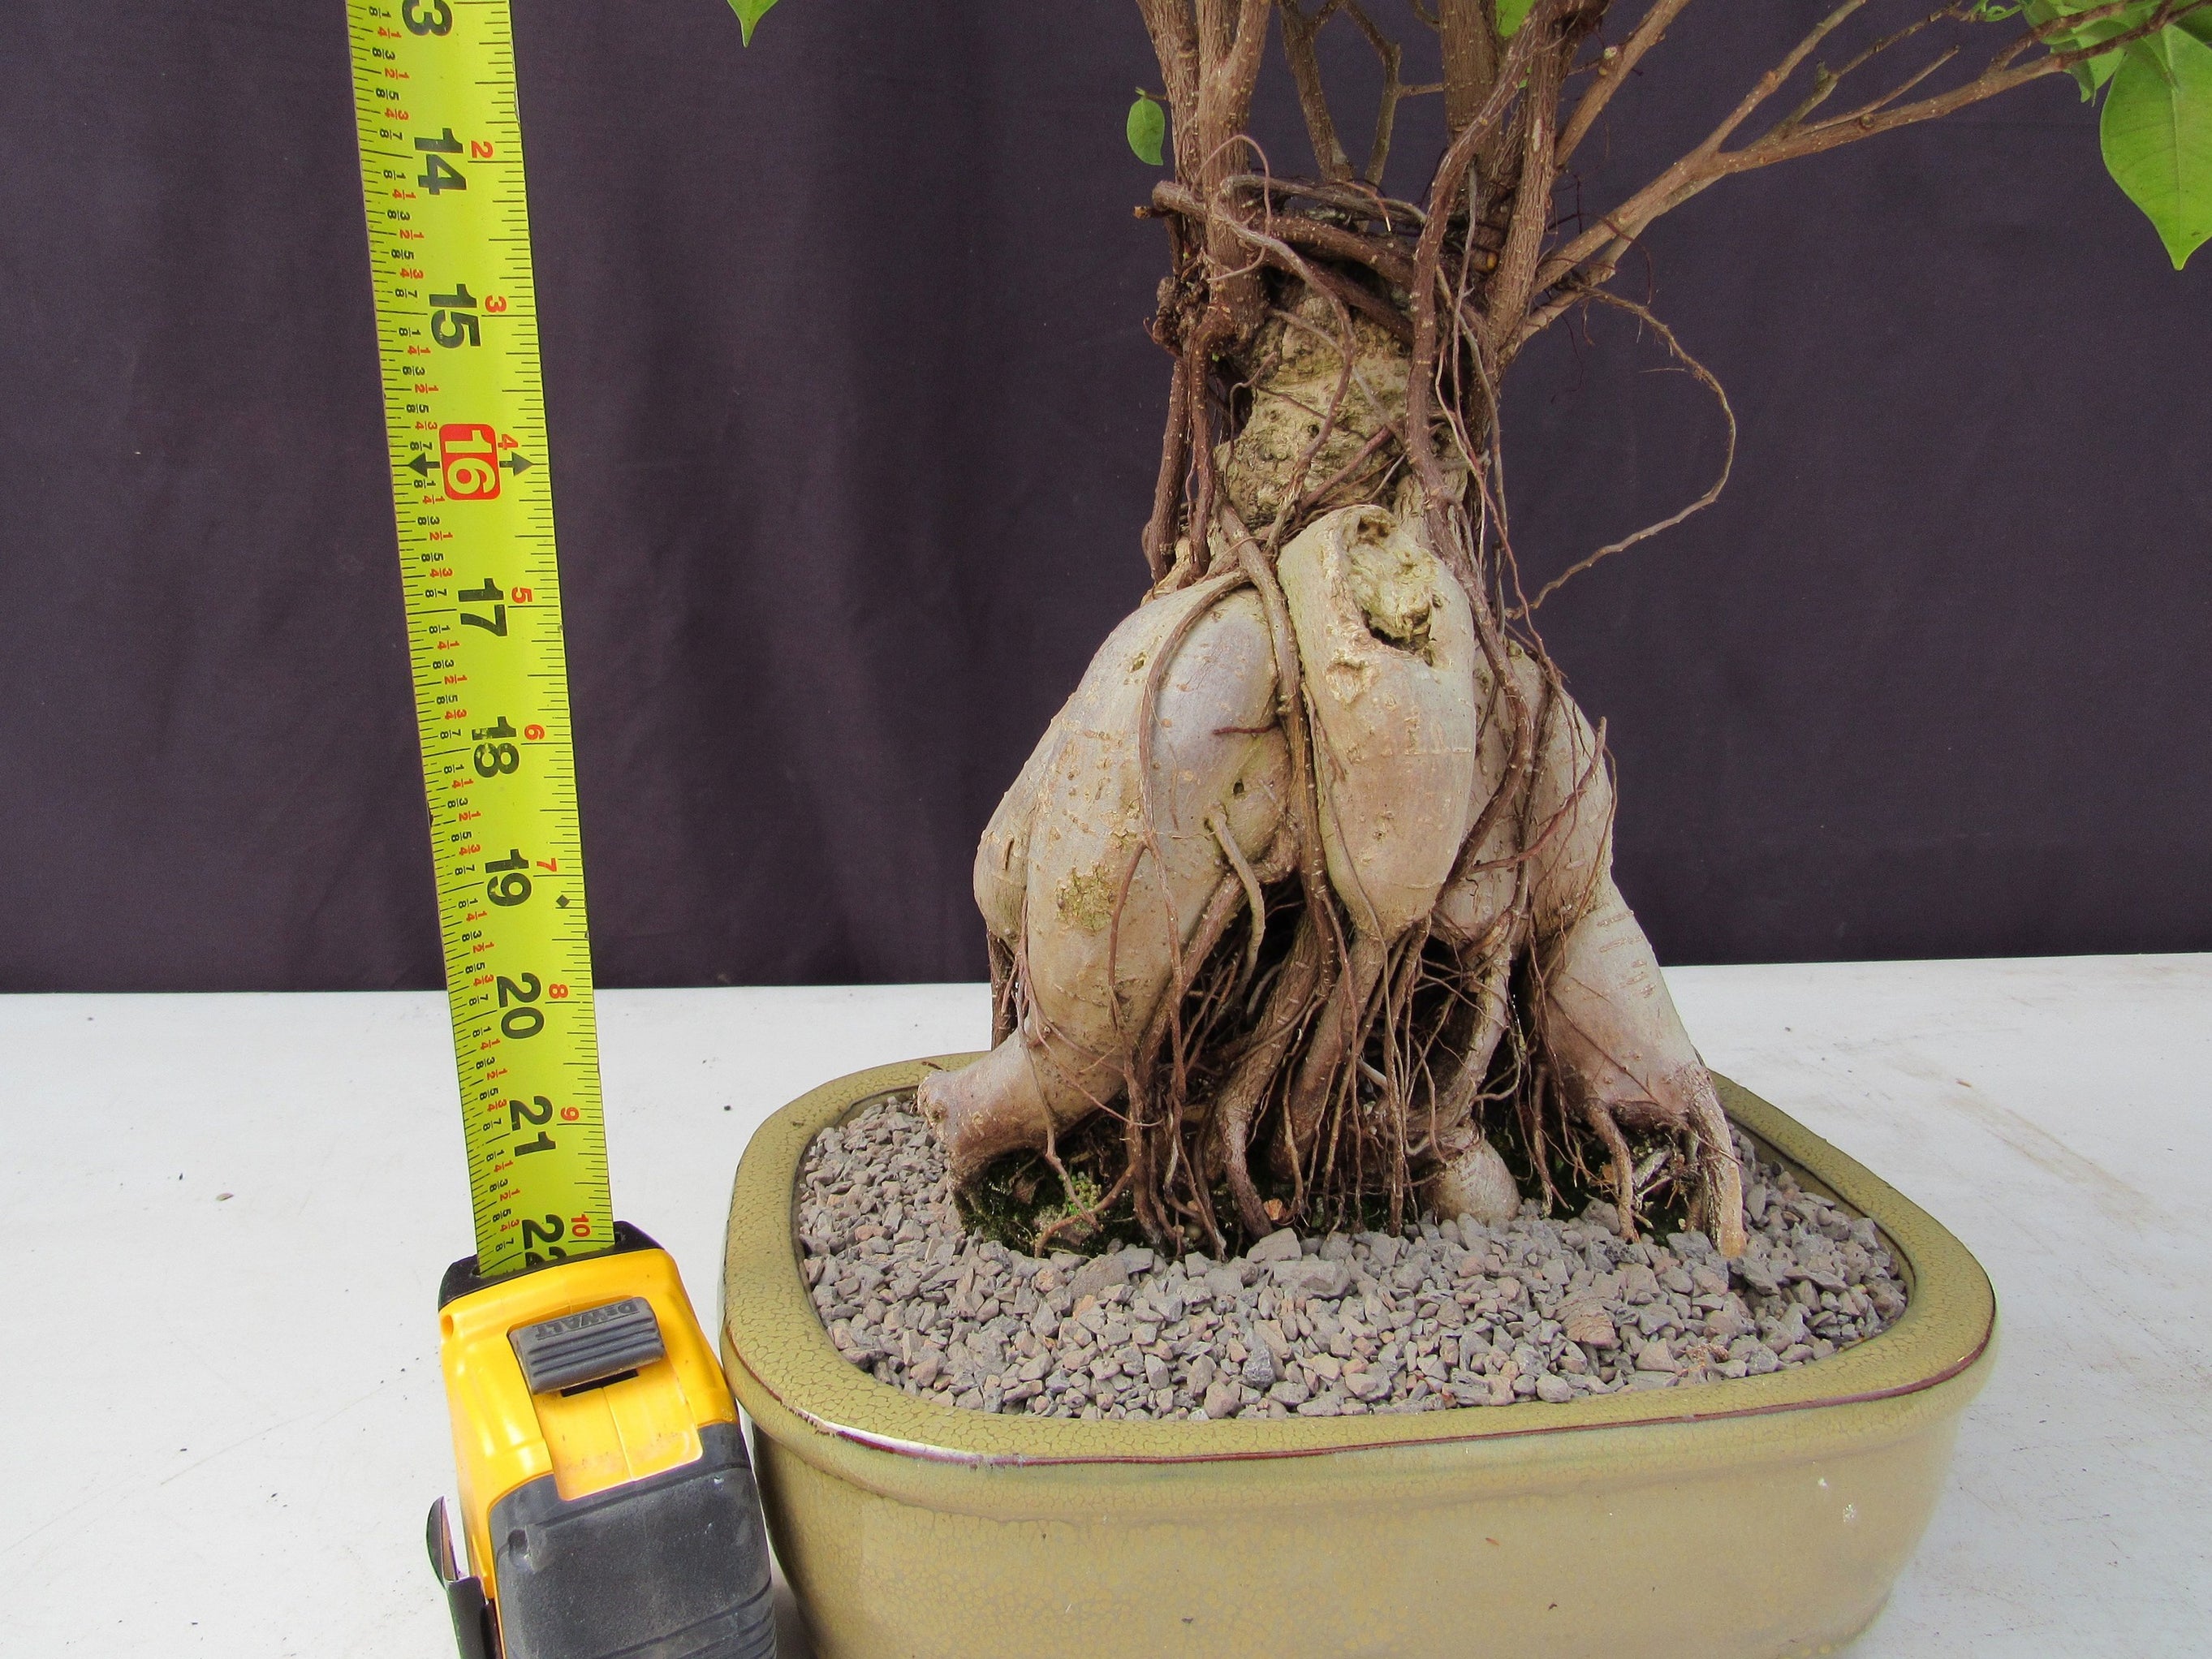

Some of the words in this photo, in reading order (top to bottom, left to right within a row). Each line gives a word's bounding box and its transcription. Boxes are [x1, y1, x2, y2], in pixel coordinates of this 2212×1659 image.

[470, 140, 493, 158] 2
[414, 128, 467, 195] 14
[485, 295, 507, 312] 3
[429, 284, 481, 348] 15
[498, 433, 519, 450] 4
[445, 430, 495, 494] 16
[458, 578, 507, 636] 17
[511, 587, 533, 603] 5
[524, 724, 545, 739] 6
[472, 716, 520, 778] 18
[537, 858, 557, 872] 7
[485, 849, 532, 907] 19
[549, 984, 567, 998] 8
[497, 972, 545, 1039] 20
[560, 1107, 580, 1121] 9
[510, 1096, 556, 1157] 21
[571, 1213, 590, 1237] 10
